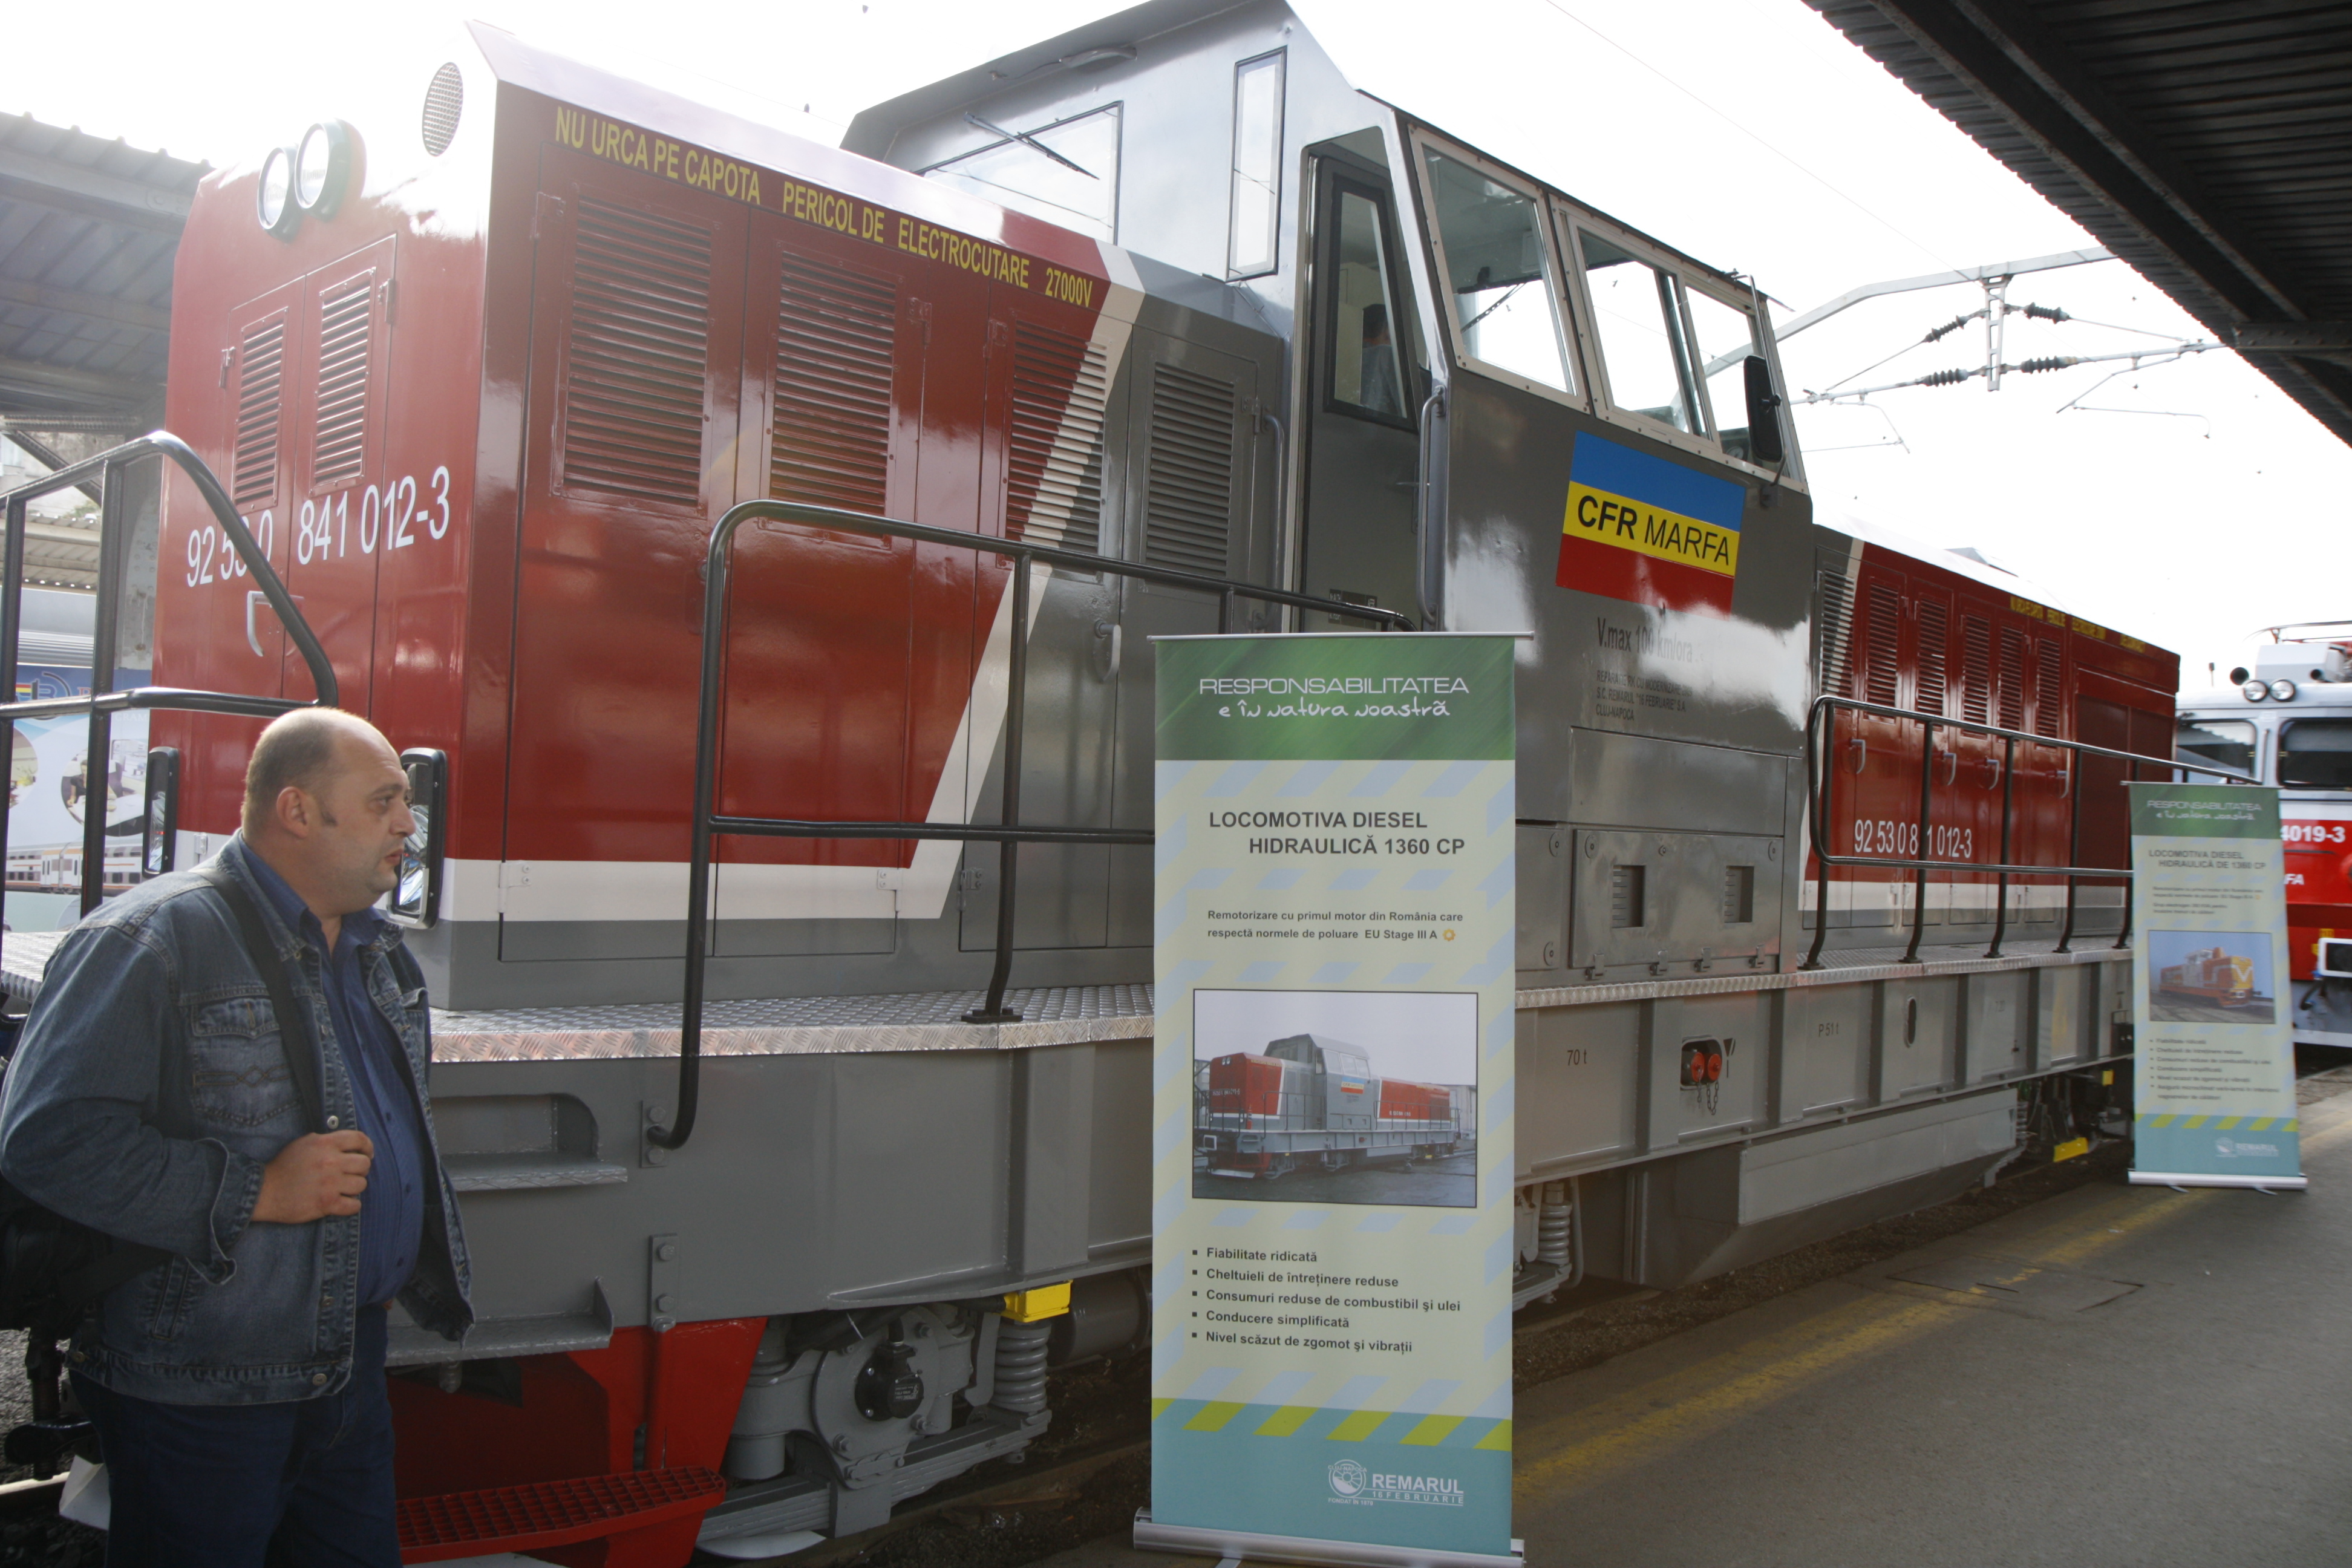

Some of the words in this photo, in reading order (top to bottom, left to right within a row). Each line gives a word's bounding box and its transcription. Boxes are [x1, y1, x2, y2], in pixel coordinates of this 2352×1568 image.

[556, 106, 584, 149] NU
[592, 122, 648, 170] URCA
[655, 139, 679, 179] PE
[685, 148, 760, 205] CAPOTA
[783, 180, 858, 236] PERICOL
[862, 206, 884, 244] DE
[898, 217, 1030, 289] ELECTROCUTARE
[1045, 267, 1093, 308] 27000V
[187, 526, 215, 587] 92
[298, 491, 348, 564] 841
[361, 466, 449, 554] 012-3
[1578, 495, 1638, 540] CFR
[1644, 515, 1730, 566] MARFA
[1598, 617, 1631, 652] V.max
[1636, 626, 1654, 656] 100
[1200, 678, 1469, 694] RESPONSABILITATEA
[1219, 705, 1230, 717] e
[1267, 697, 1349, 717] natura
[1596, 704, 1634, 720] CLUJ-NAPOCA
[1209, 812, 1347, 828] LOCOMOTIVA
[1353, 812, 1428, 828] DIESEL
[1249, 835, 1377, 855] HIDRAULICĂ
[1385, 838, 1429, 854] 1360
[1437, 839, 1465, 855] CP
[1855, 819, 1872, 852] 92
[1877, 820, 1894, 854] 53
[1937, 825, 1972, 858] 012-3
[1208, 910, 1278, 921] Remotorizare
[1281, 912, 1293, 921] cu
[1298, 911, 1331, 923] primul
[1334, 912, 1366, 921] motor
[1370, 912, 1385, 921] din
[1390, 912, 1437, 922] România
[1440, 913, 1463, 922] care
[1208, 928, 1252, 939] respectă
[1256, 930, 1299, 939] normele
[1302, 930, 1315, 938] de
[1318, 930, 1358, 941] poluare
[1365, 930, 1380, 939] EU
[1383, 930, 1413, 941] Stage
[1417, 930, 1426, 939] III
[1429, 930, 1437, 939] A
[1567, 1049, 1580, 1066] 70
[1206, 1247, 1267, 1261] Fiabilitate
[1271, 1250, 1318, 1263] ridicată
[1206, 1269, 1264, 1282] Cheltuieli
[1268, 1272, 1283, 1283] de
[1355, 1276, 1399, 1287] reduse
[1206, 1289, 1274, 1304] Consumuri
[1278, 1293, 1321, 1305] reduse
[1325, 1295, 1340, 1306] de
[1344, 1296, 1419, 1310] combustibil
[1438, 1300, 1460, 1312] ulei
[1206, 1310, 1273, 1325] Conducere
[1277, 1314, 1350, 1329] simplificată
[1206, 1331, 1236, 1344] Nivel
[1240, 1333, 1281, 1346] scăzut
[1284, 1336, 1299, 1347] de
[1303, 1338, 1350, 1350] zgomot
[1372, 1474, 1464, 1494] REMARUL
